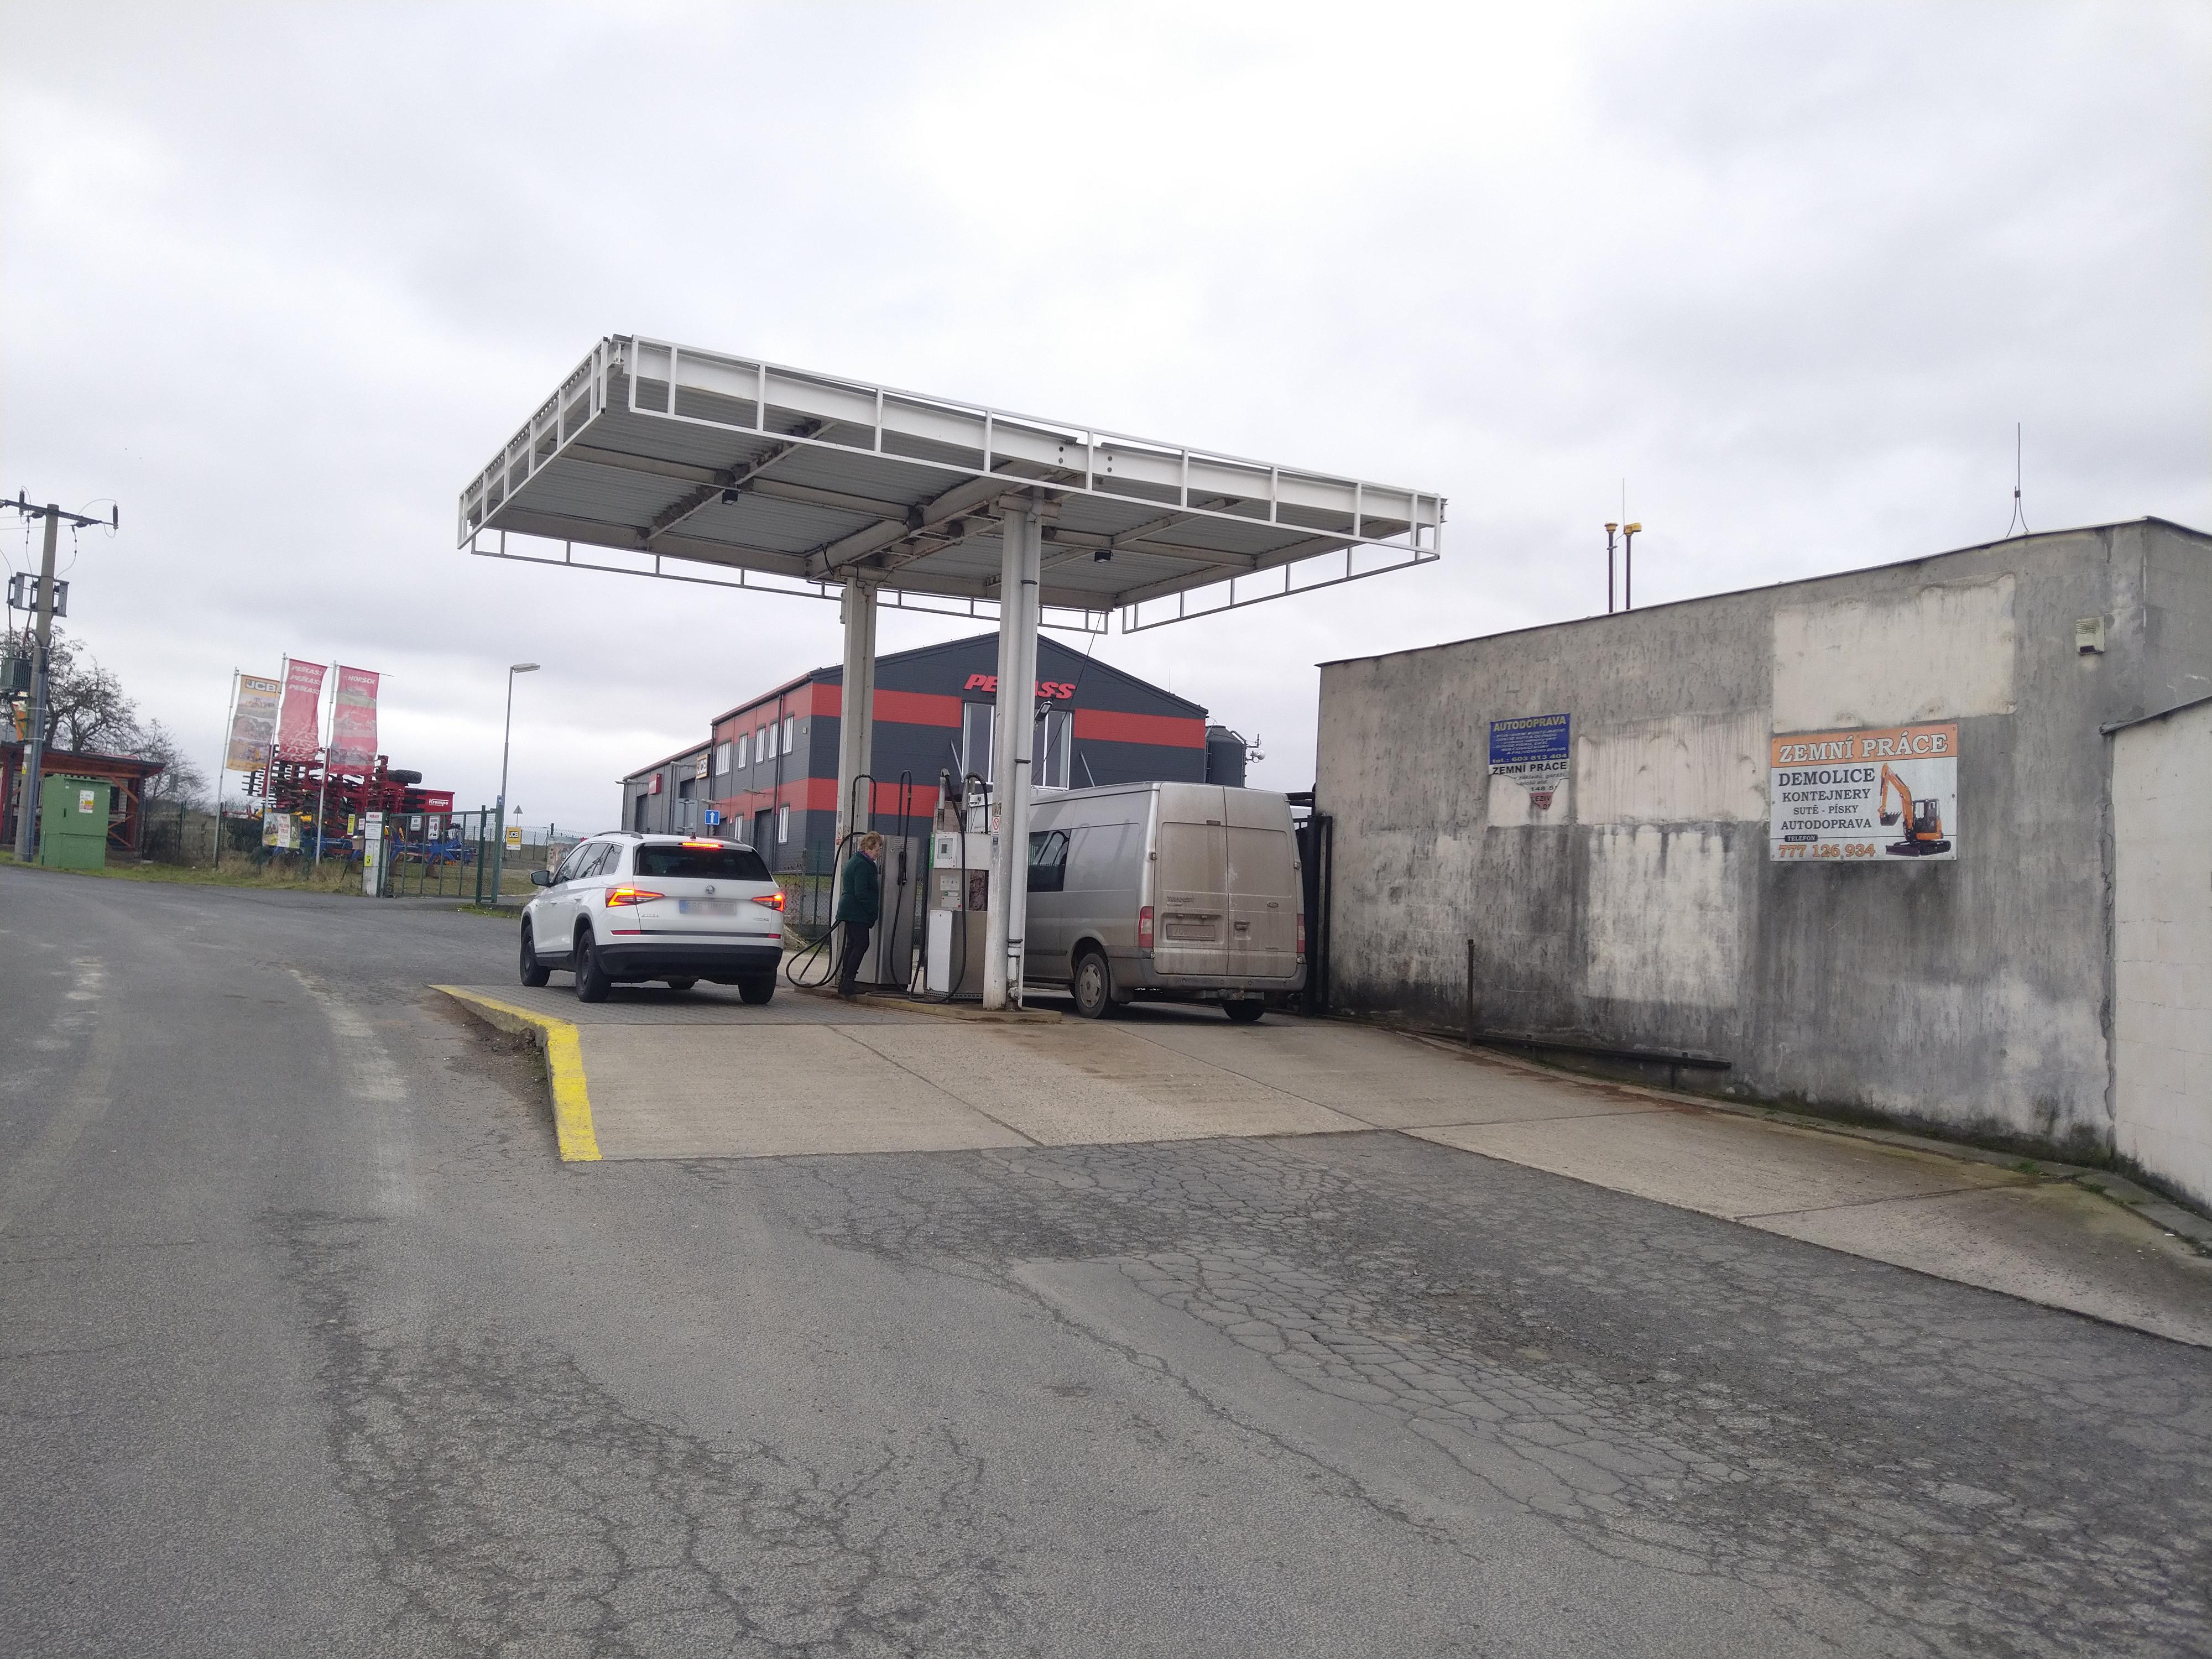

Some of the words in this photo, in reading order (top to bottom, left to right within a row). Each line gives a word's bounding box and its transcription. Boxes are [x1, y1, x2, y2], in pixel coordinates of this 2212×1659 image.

[246, 680, 276, 692] JCB
[348, 675, 375, 685] HORSCH
[964, 674, 1076, 699] PESS
[1494, 716, 1567, 732] AUTODOPRAVA
[1779, 734, 1854, 763] ZEMNÍ
[1861, 731, 1949, 758] PRÁCE
[697, 759, 707, 775] JCB
[1493, 763, 1526, 775] ZEMNÍ
[1530, 761, 1567, 772] PRÁCE
[1778, 768, 1875, 786] DEMOLICE
[1782, 789, 1871, 802] KONTEJNERY
[1828, 804, 1859, 814] PÍSKY
[1781, 818, 1872, 830] AUTODOPRAVA
[1778, 844, 1807, 857] 777
[1812, 844, 1841, 857] 126
[1845, 843, 1876, 857] 934
